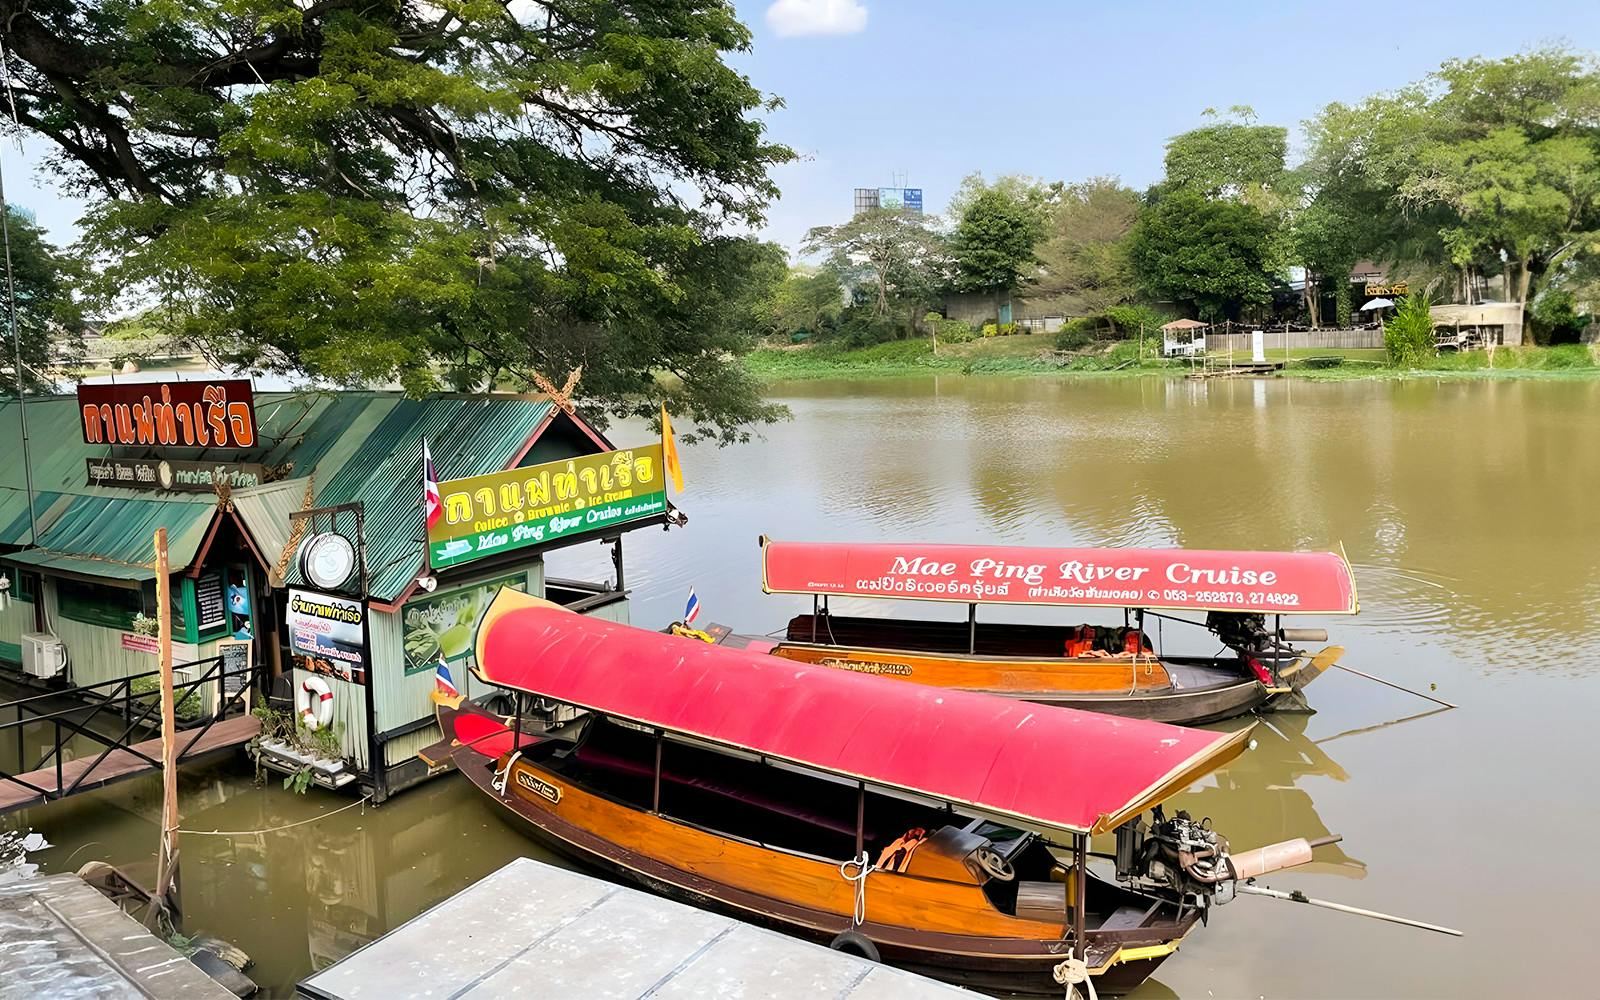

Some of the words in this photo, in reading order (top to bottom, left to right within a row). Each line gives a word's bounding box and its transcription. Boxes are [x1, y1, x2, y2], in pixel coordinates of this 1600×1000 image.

[83, 384, 253, 447] กาแฟท่าเรือ
[444, 450, 654, 525] กาแฟท่าเรือ
[588, 495, 603, 507] Ice
[887, 556, 957, 577] Mae
[969, 557, 1047, 585] Ping
[1058, 560, 1150, 583] River
[1165, 563, 1278, 586] Cruise
